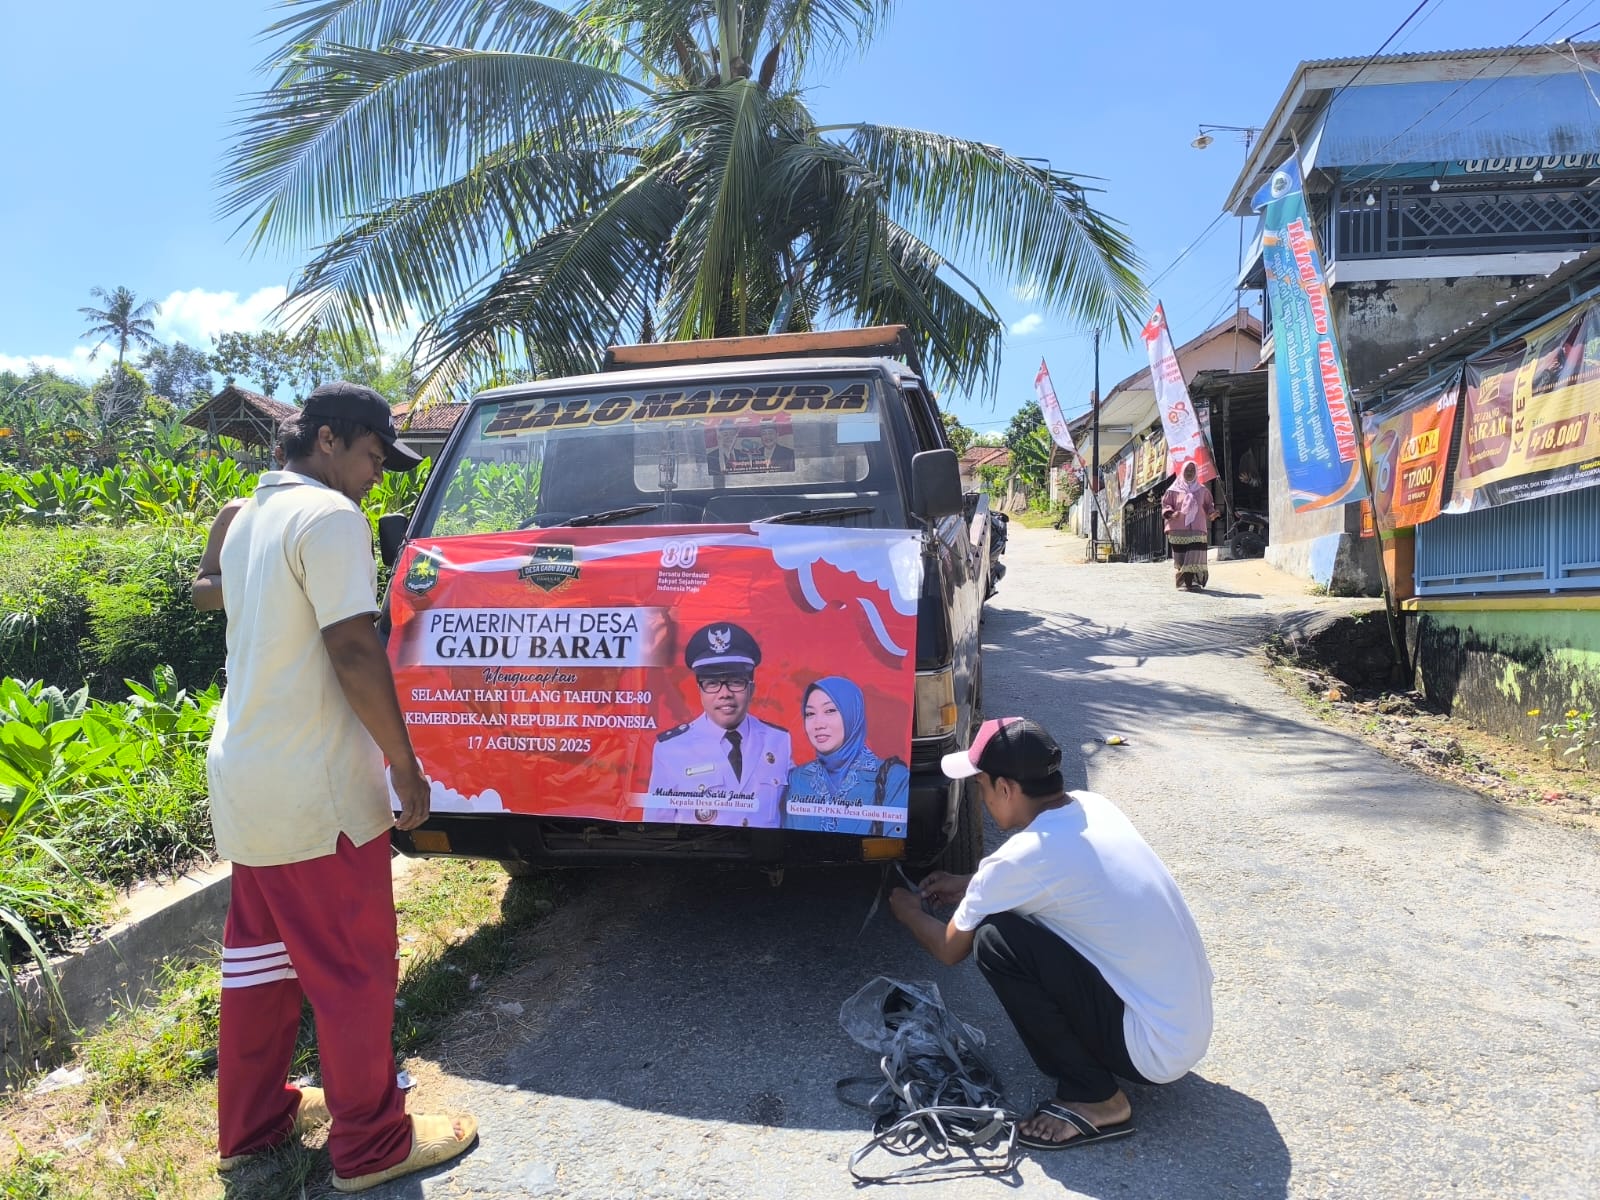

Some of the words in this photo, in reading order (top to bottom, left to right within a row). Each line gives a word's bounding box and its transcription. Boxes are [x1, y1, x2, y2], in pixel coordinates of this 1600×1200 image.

[631, 383, 871, 421] MADURA
[1468, 416, 1508, 445] GARAM
[660, 541, 698, 569] 80
[430, 613, 571, 634] PEMERINTAH
[579, 612, 639, 633] DESA
[435, 635, 519, 659] GADU
[528, 634, 632, 659] BARAT
[482, 666, 577, 688] Mengucapkan
[411, 689, 471, 702] SELAMAT
[474, 690, 508, 703] HARI
[511, 690, 560, 703] ULANG
[564, 690, 612, 704] TAHUN
[614, 690, 652, 704] KE-80
[405, 712, 507, 726] KEMERDEKAAN
[511, 714, 578, 728] REPUBLIK
[582, 715, 657, 729] INDONESIA
[467, 736, 482, 750] 17
[485, 736, 556, 751] AGUSTUS
[559, 738, 591, 753] 2025
[652, 787, 704, 799] Muhammad
[669, 798, 694, 808] Kepala
[695, 799, 711, 808] Desa
[712, 799, 733, 809] Gadu
[734, 800, 754, 809] Barat
[790, 804, 809, 814] Ketua
[843, 808, 859, 817] Desa
[861, 808, 881, 819] Gadu
[882, 810, 903, 820] Barat
